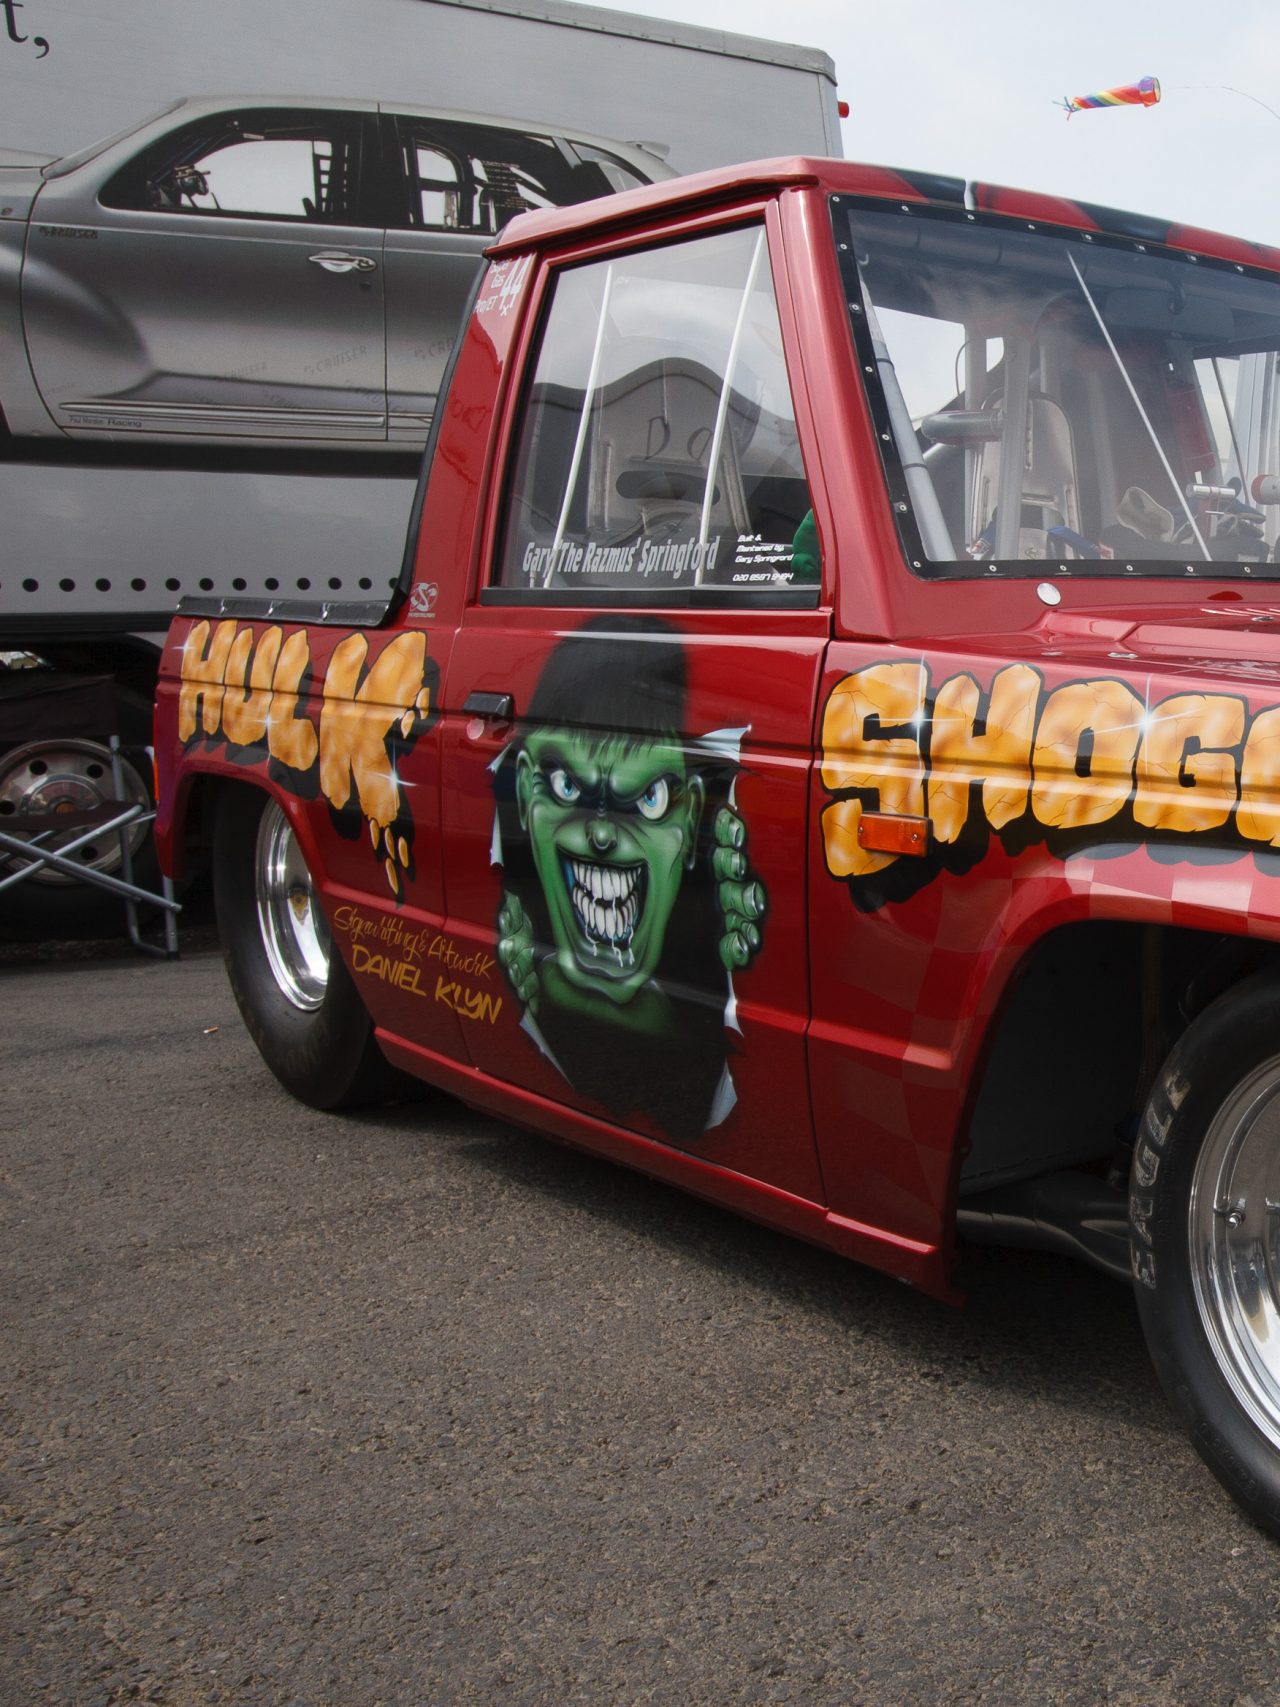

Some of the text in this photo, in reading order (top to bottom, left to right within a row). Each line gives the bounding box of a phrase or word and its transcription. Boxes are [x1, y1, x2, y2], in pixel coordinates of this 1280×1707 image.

[499, 253, 533, 310] 44
[522, 541, 556, 579] Gary
[637, 535, 721, 580] Springford
[735, 555, 753, 564] Gary
[178, 619, 429, 830] HULK
[352, 944, 503, 1024] DANIEL KLYN
